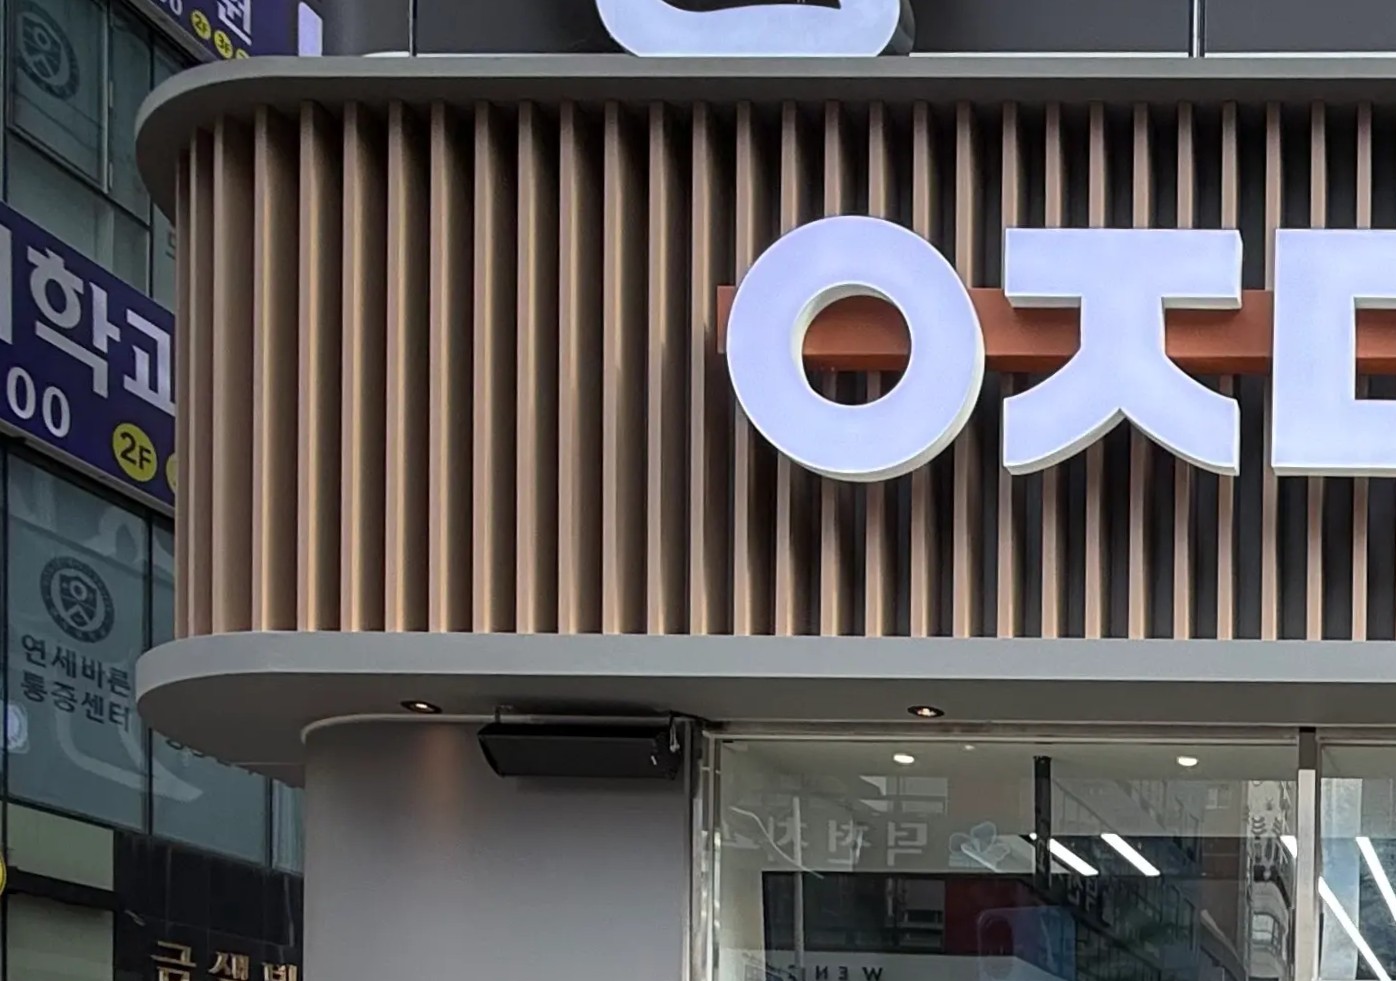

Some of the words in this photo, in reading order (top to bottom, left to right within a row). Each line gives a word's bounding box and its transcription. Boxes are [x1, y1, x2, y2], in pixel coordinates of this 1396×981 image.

[119, 431, 152, 470] 2F
[22, 633, 131, 698] 연세바른
[20, 671, 131, 731] 통증센터
